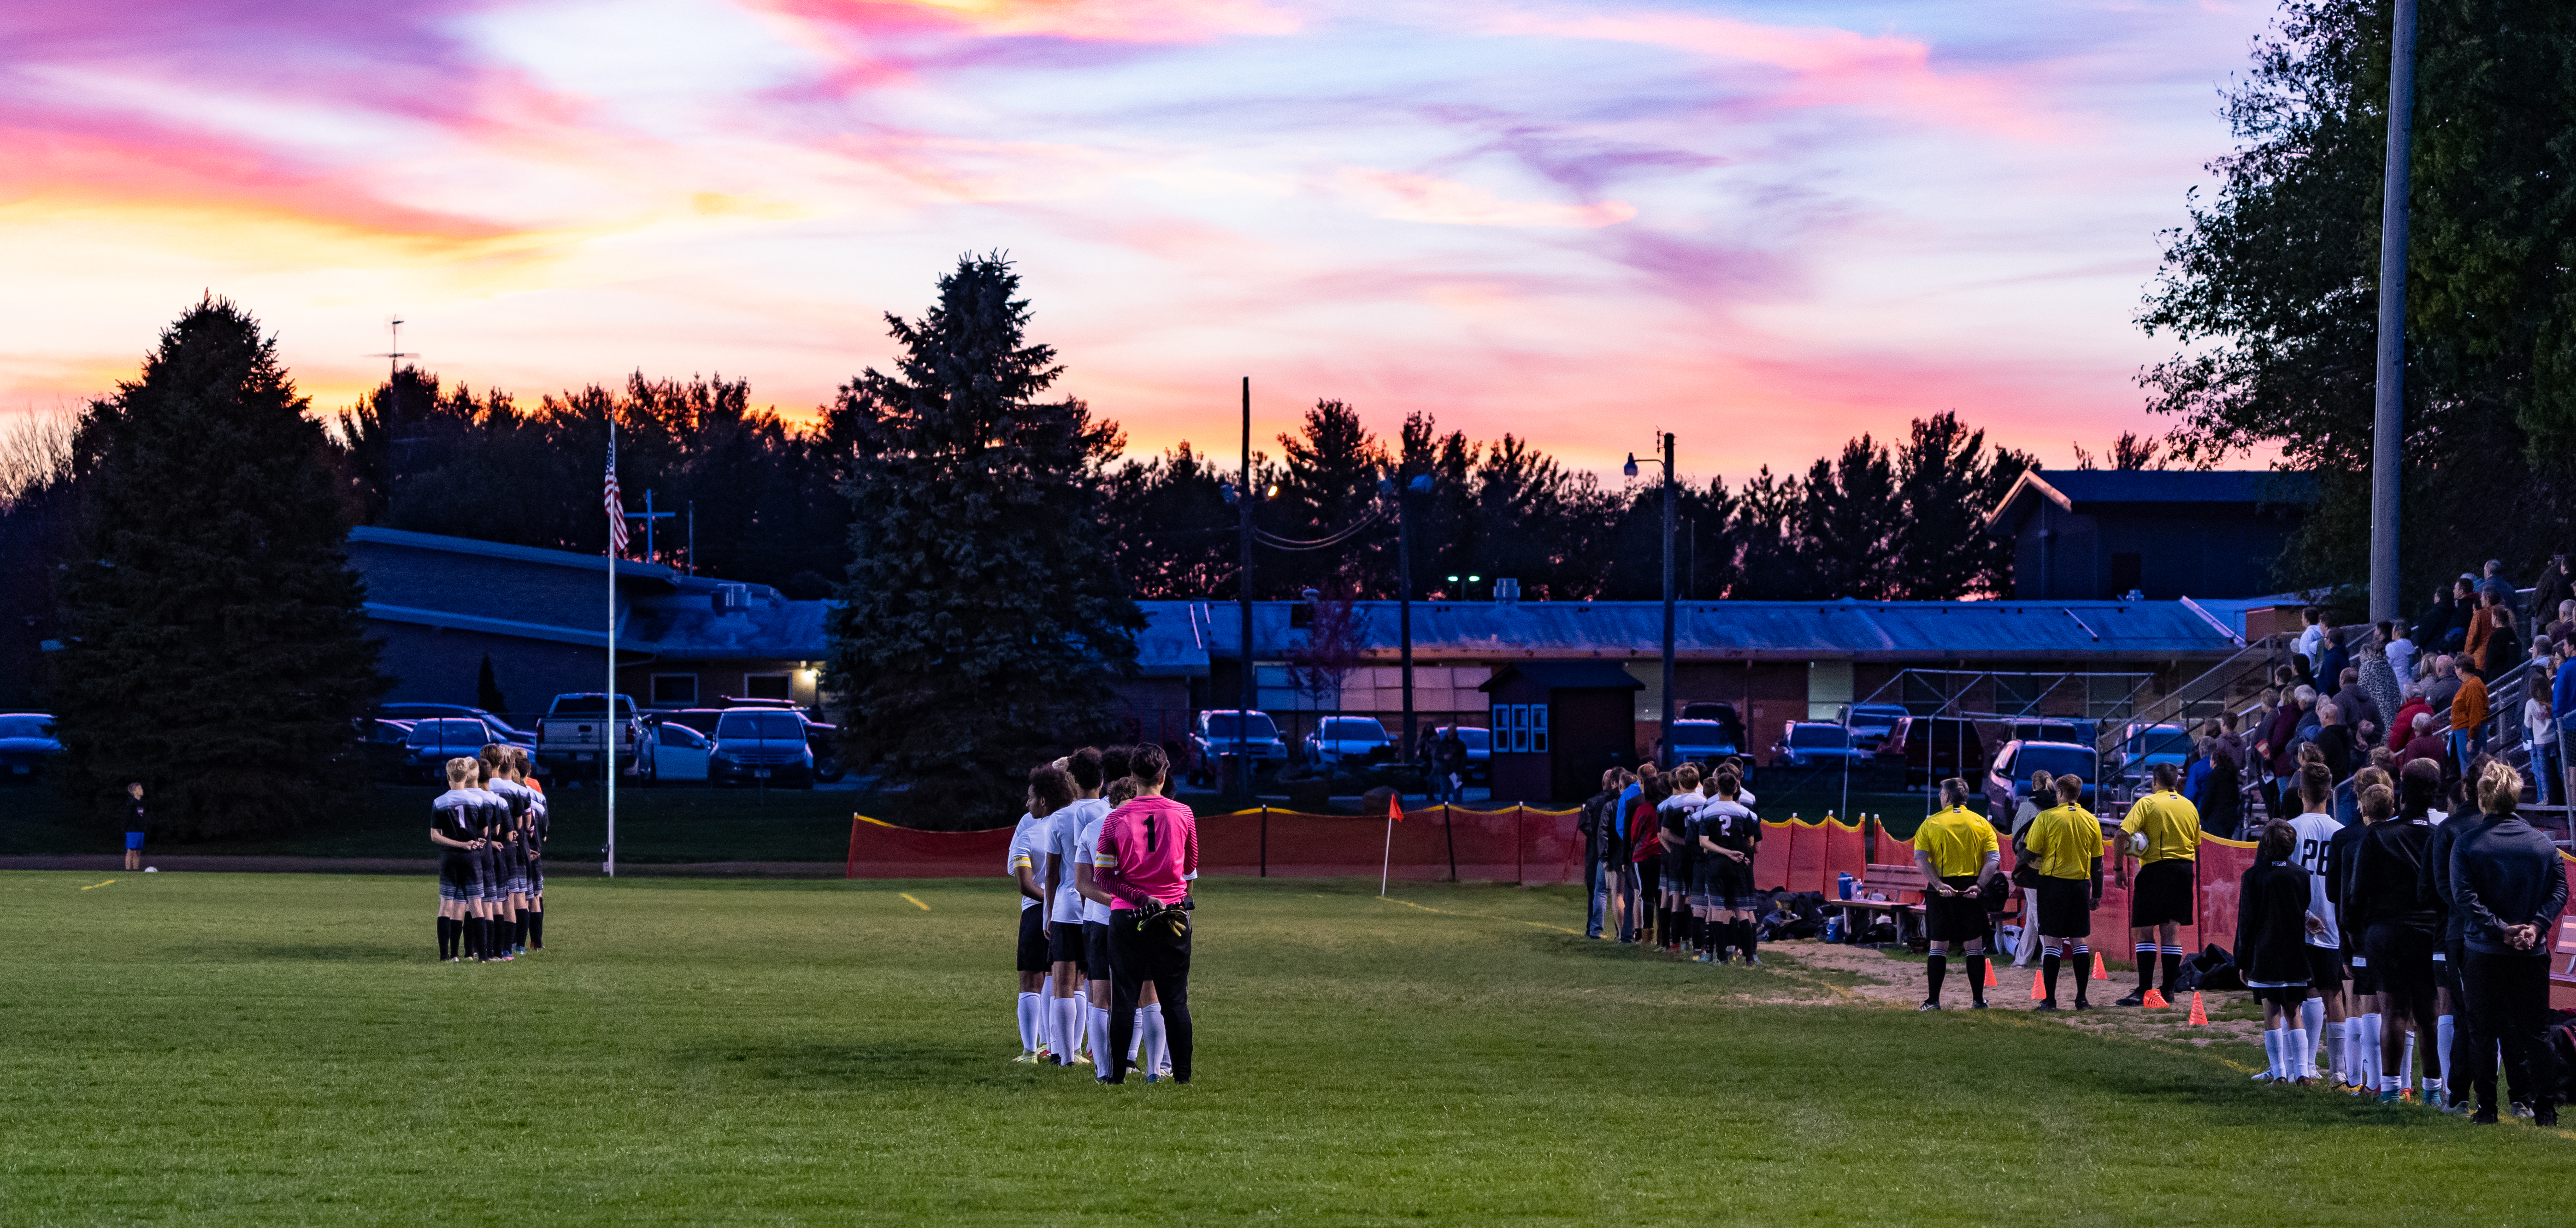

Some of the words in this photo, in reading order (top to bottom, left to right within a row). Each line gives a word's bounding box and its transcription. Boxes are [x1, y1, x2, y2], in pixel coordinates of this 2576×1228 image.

[455, 805, 466, 828] 1
[1719, 815, 1731, 836] 2
[1144, 815, 1155, 852] 1
